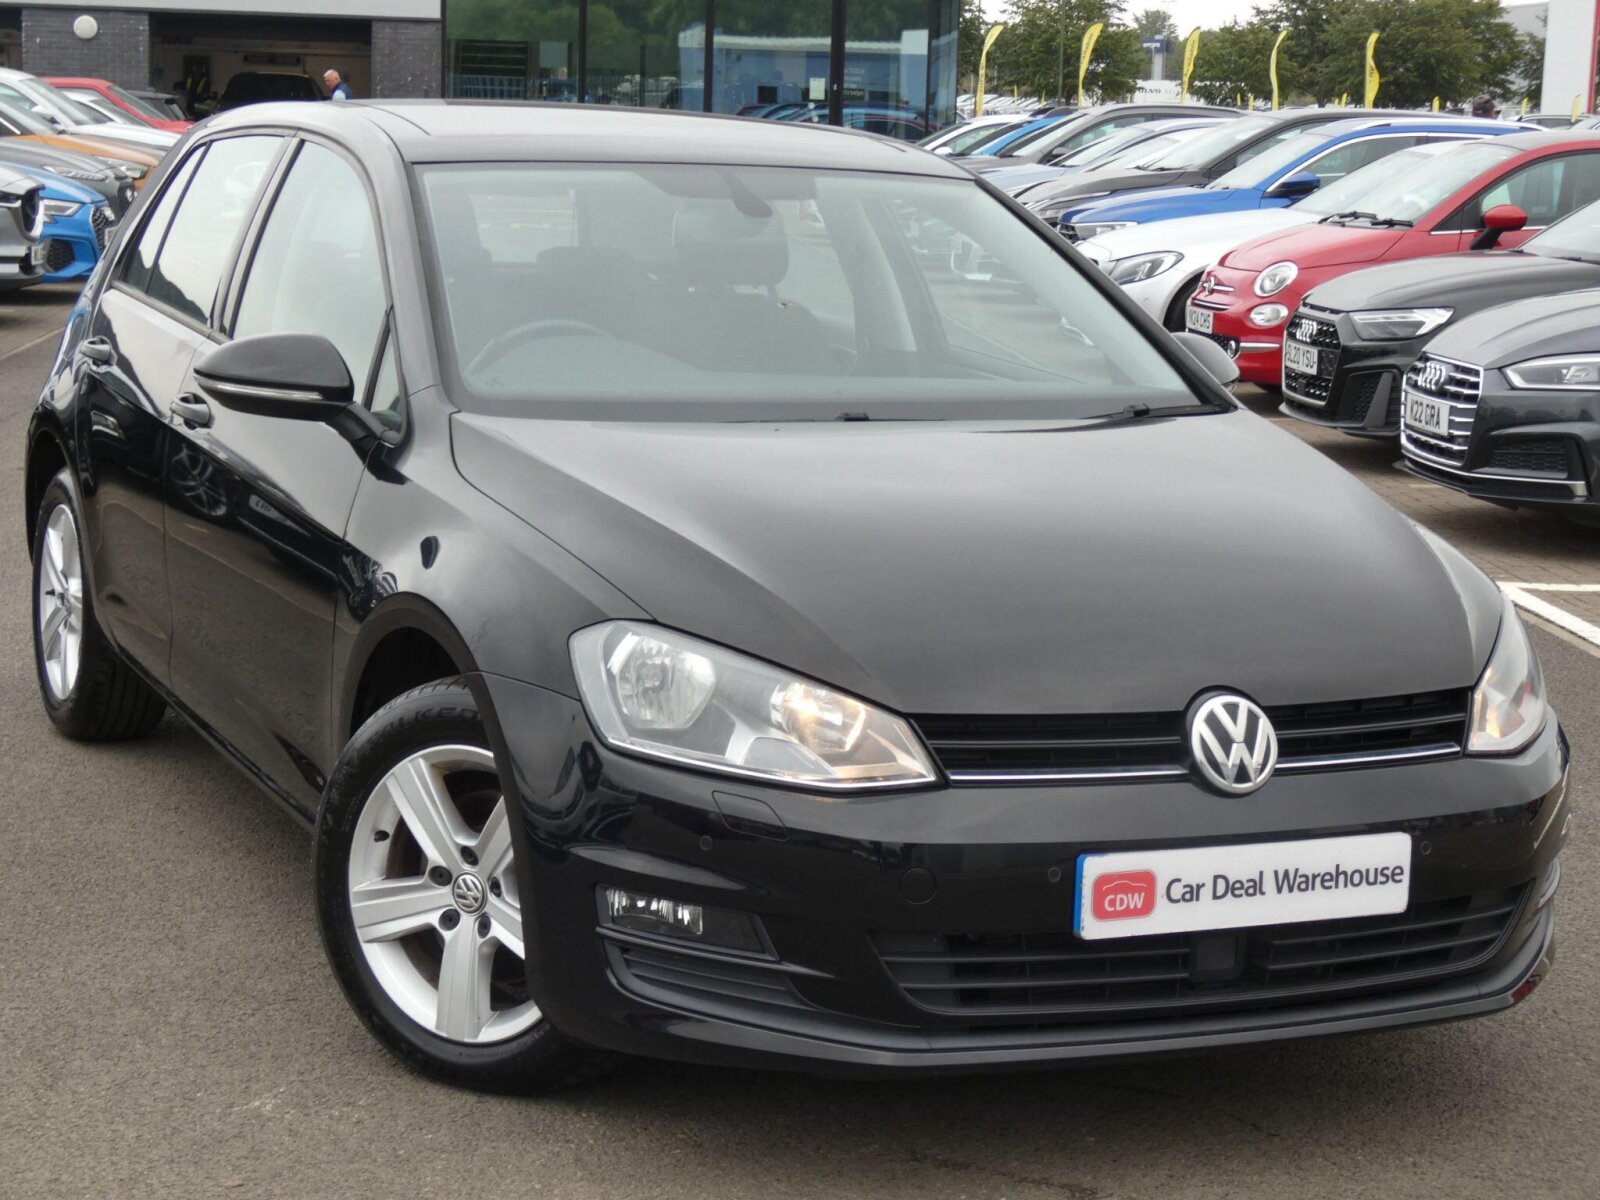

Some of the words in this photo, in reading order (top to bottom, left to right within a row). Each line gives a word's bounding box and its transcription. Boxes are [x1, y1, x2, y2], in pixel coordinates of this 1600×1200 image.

[1410, 398, 1424, 424] K22
[1165, 877, 1205, 904] Car
[1211, 871, 1266, 900] Deal
[1273, 864, 1404, 895] Warehouse
[1104, 892, 1145, 912] CDW
